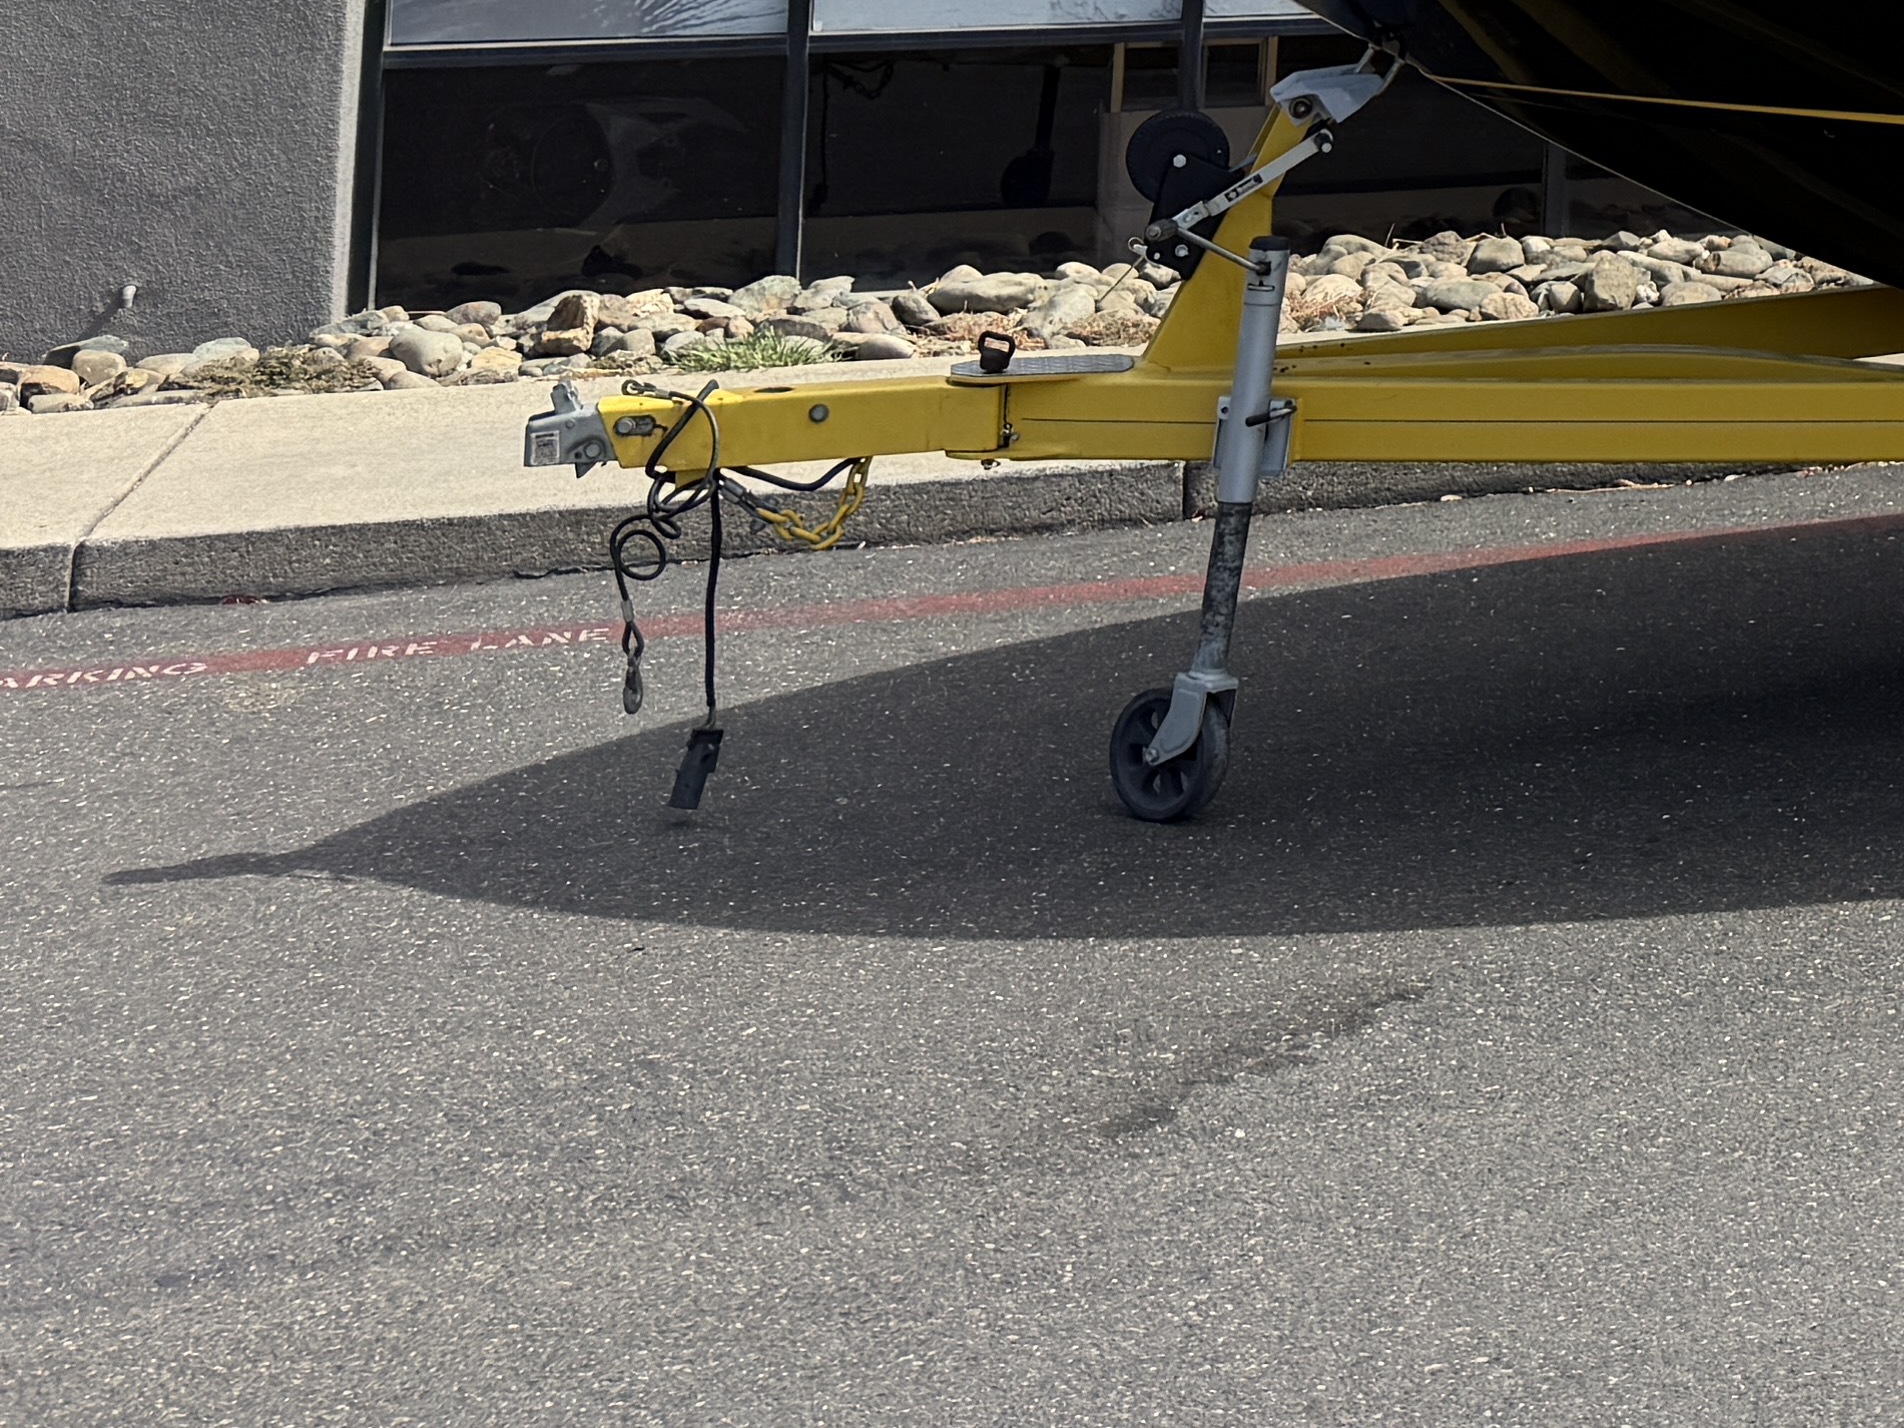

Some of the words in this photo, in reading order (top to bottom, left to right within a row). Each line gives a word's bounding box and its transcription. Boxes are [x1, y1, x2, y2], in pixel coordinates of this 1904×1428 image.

[0, 662, 209, 689] ARKING
[306, 640, 438, 666] FIRE
[470, 627, 610, 651] LANE
